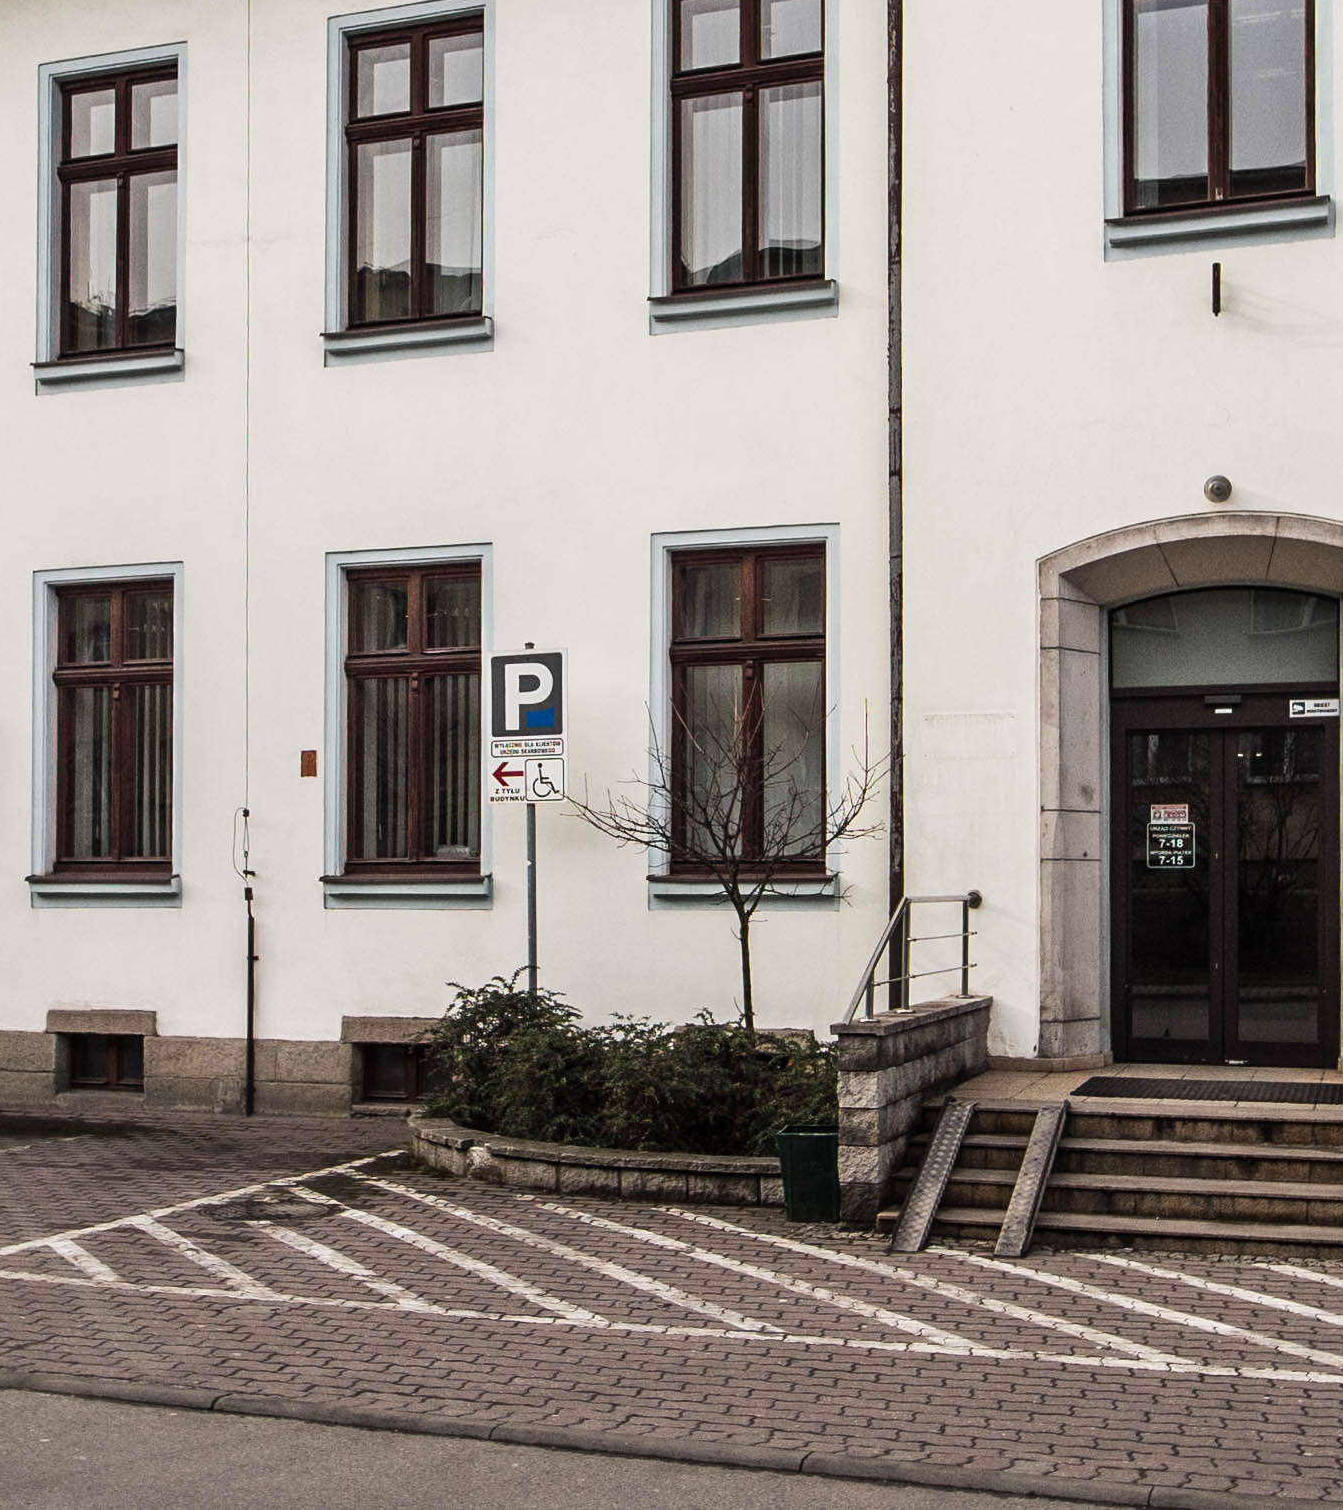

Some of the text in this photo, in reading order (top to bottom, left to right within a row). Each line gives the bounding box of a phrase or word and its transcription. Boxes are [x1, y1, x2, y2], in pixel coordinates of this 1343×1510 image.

[505, 663, 554, 731] P
[1159, 838, 1184, 848] 7-18
[1159, 855, 1184, 865] 7-15
